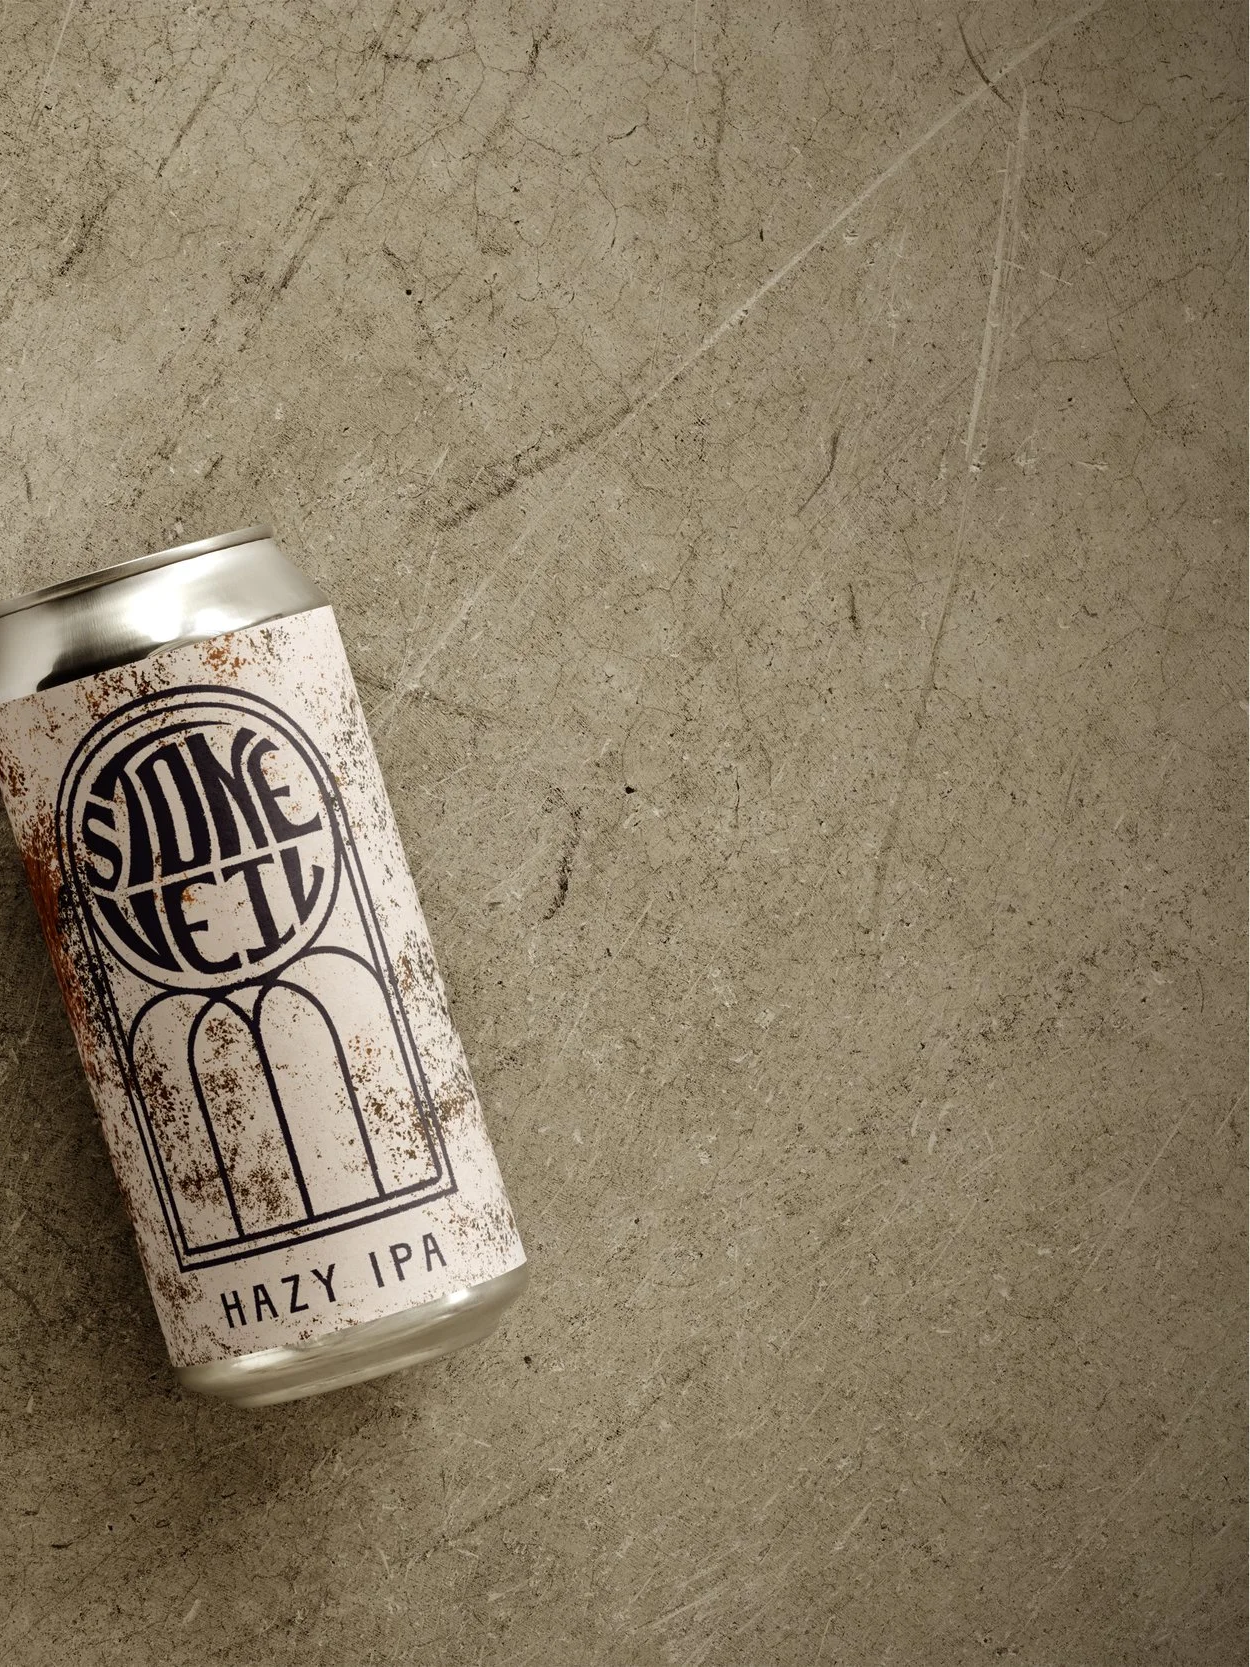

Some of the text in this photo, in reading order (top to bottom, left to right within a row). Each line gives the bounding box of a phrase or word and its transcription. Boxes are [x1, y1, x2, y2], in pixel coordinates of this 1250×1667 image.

[82, 721, 323, 892] STONE
[94, 846, 325, 974] VEIL
[220, 1232, 447, 1328] HAZY IPA
